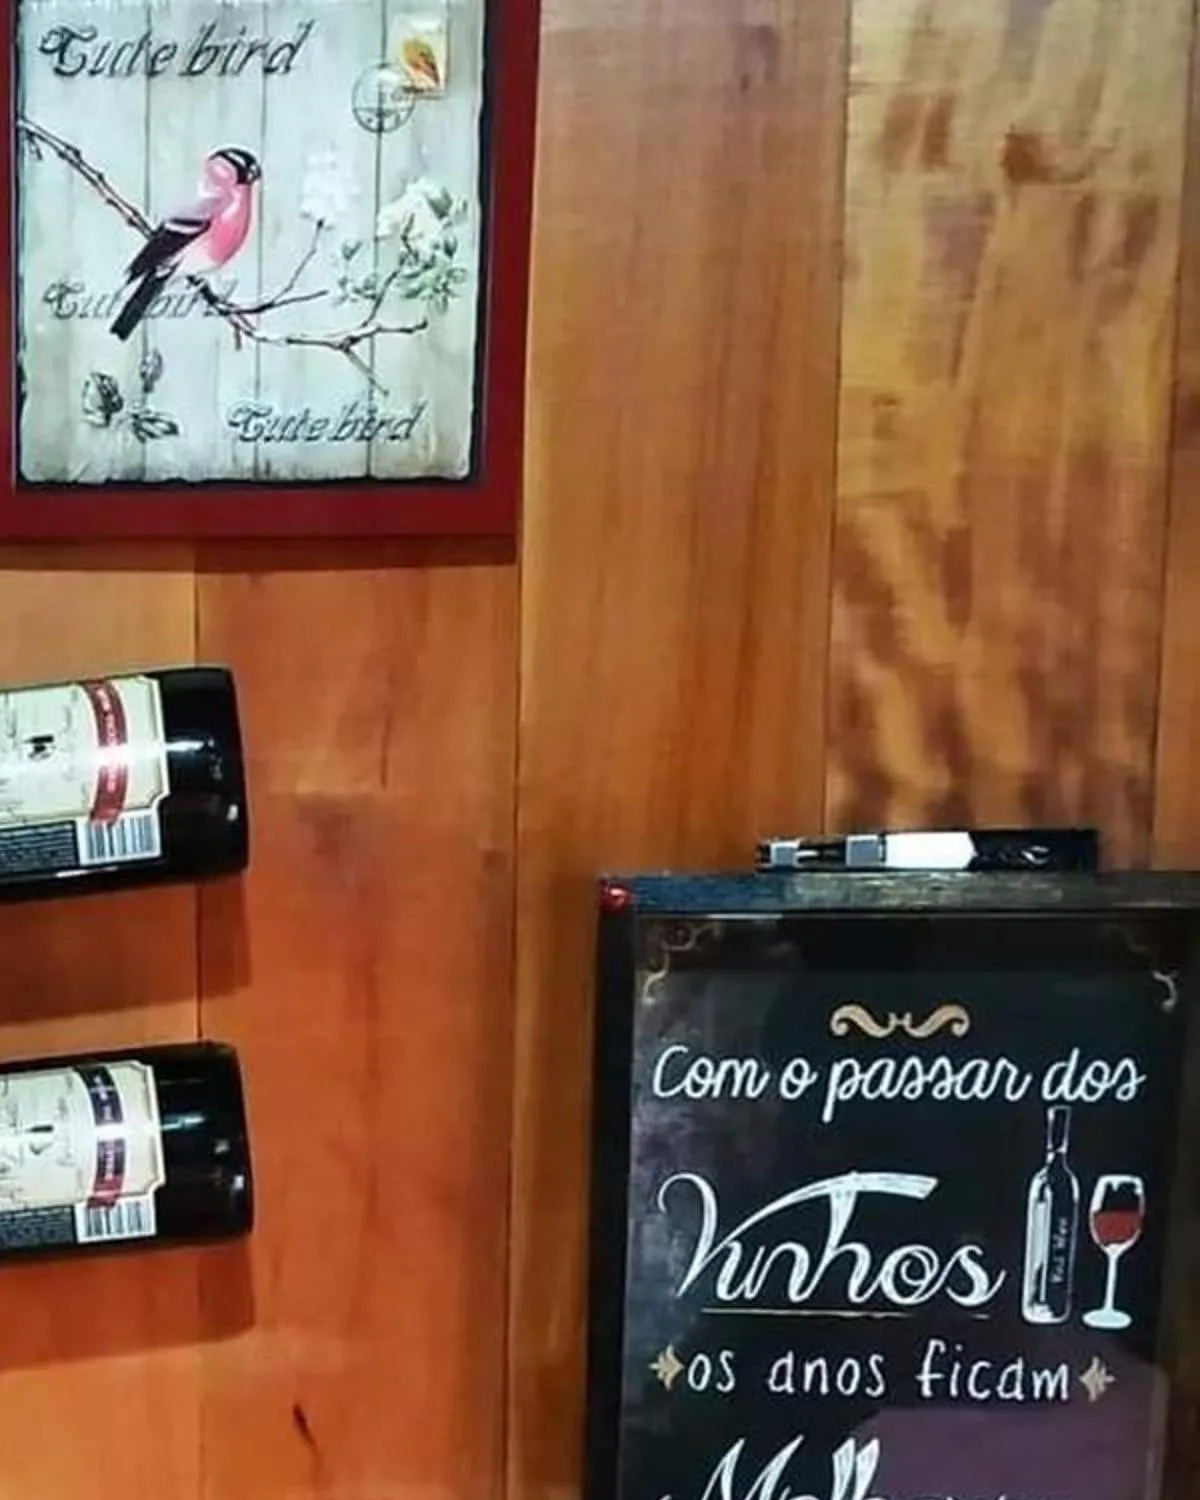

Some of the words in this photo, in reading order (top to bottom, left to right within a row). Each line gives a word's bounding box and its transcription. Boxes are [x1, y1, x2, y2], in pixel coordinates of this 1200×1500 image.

[179, 19, 315, 79] bird
[332, 399, 428, 443] bird
[652, 1045, 770, 1100] Com
[779, 1055, 817, 1101] o
[822, 1054, 1032, 1124] passar
[1041, 1047, 1147, 1102] dos
[657, 1170, 1007, 1305] Vinhos
[687, 1350, 735, 1393] os
[768, 1349, 886, 1397] anos
[915, 1337, 1071, 1400] ficam
